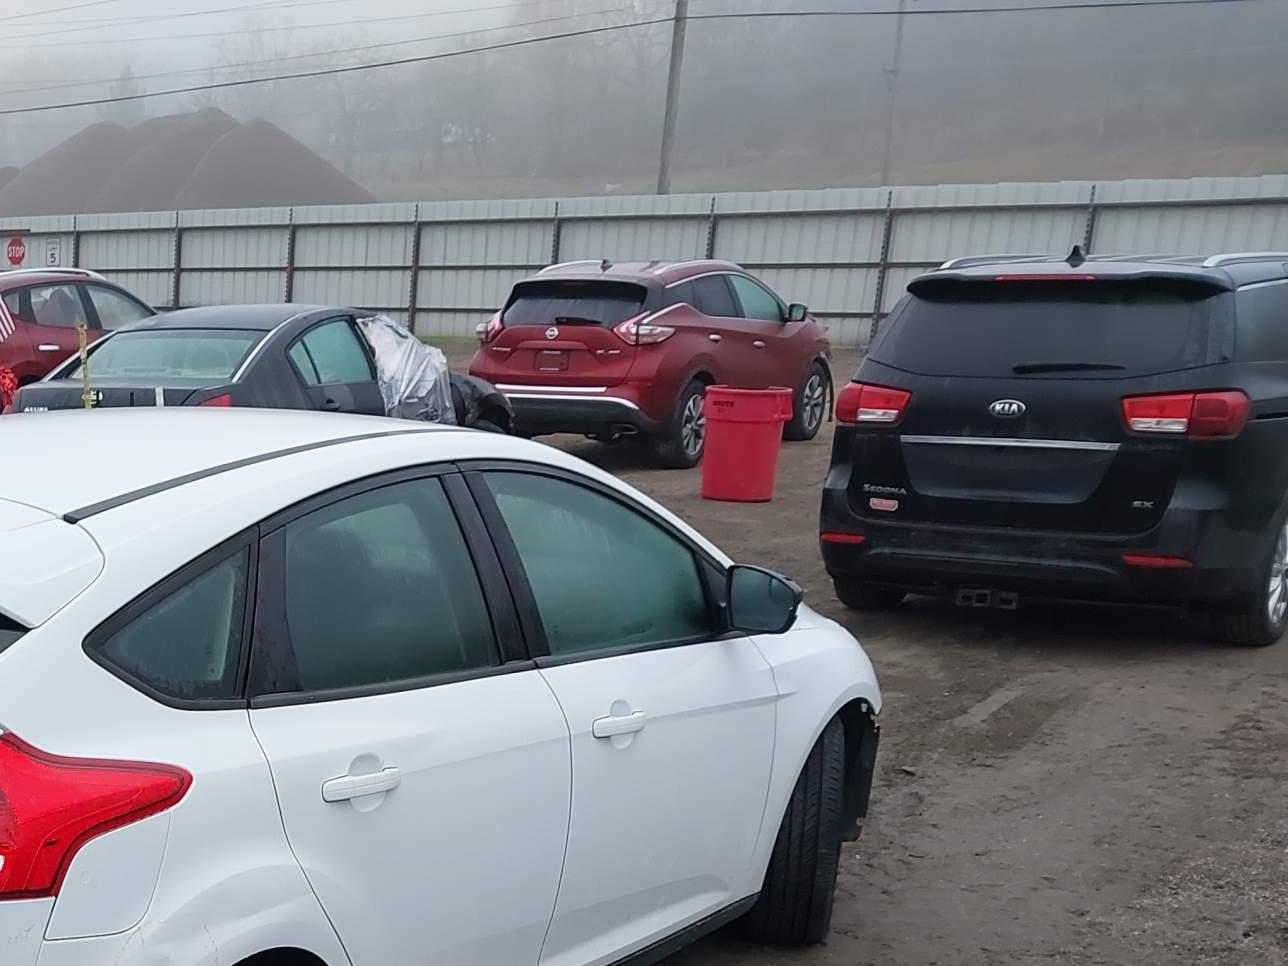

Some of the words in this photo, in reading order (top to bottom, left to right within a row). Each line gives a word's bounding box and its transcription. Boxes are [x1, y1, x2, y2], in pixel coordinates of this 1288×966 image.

[8, 246, 24, 258] STOP
[50, 252, 57, 264] 5
[995, 403, 1019, 414] KIA
